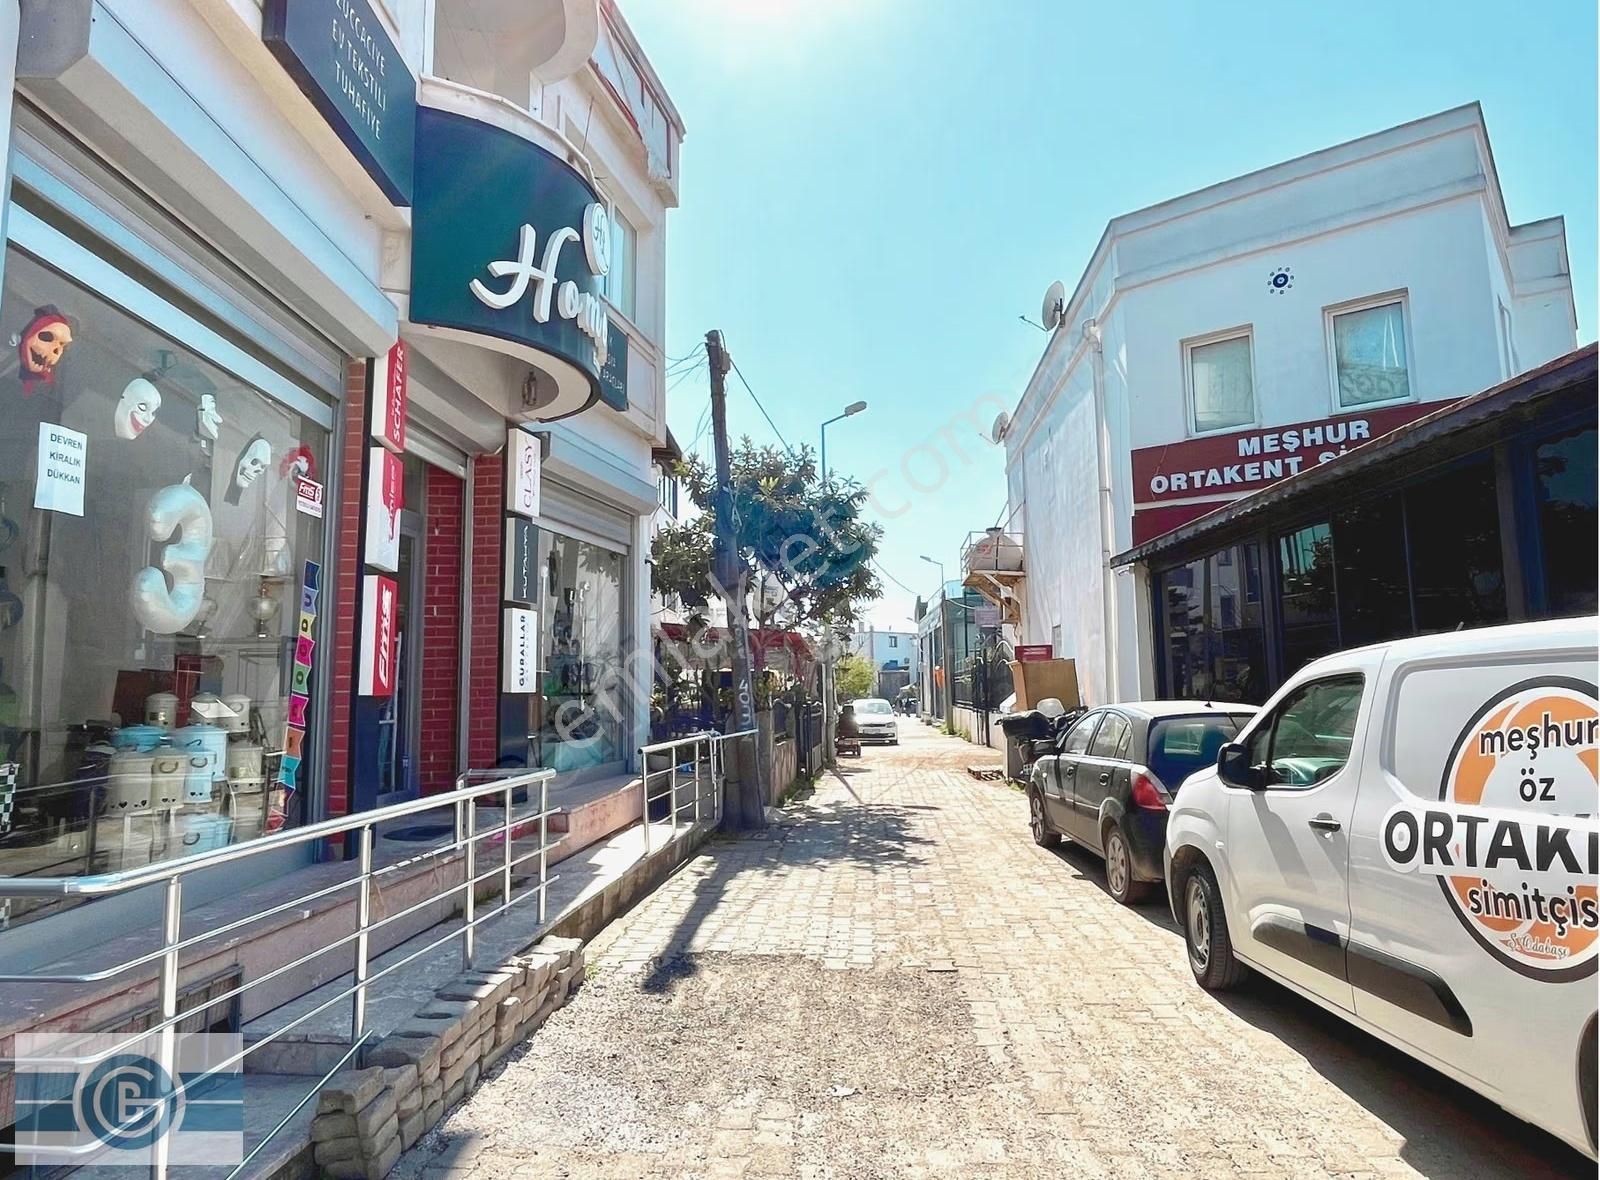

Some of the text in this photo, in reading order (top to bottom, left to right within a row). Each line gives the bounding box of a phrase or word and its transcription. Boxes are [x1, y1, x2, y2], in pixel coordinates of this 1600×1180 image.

[332, 19, 345, 49] EV
[50, 433, 82, 451] DEVREN
[1238, 419, 1370, 457] MEŞHUR
[49, 451, 81, 468] KİRALIK
[47, 468, 80, 484] DÜKKAN
[1150, 457, 1303, 494] ORTAKENT
[1480, 713, 1598, 761] meşhur
[1519, 768, 1556, 801] öz
